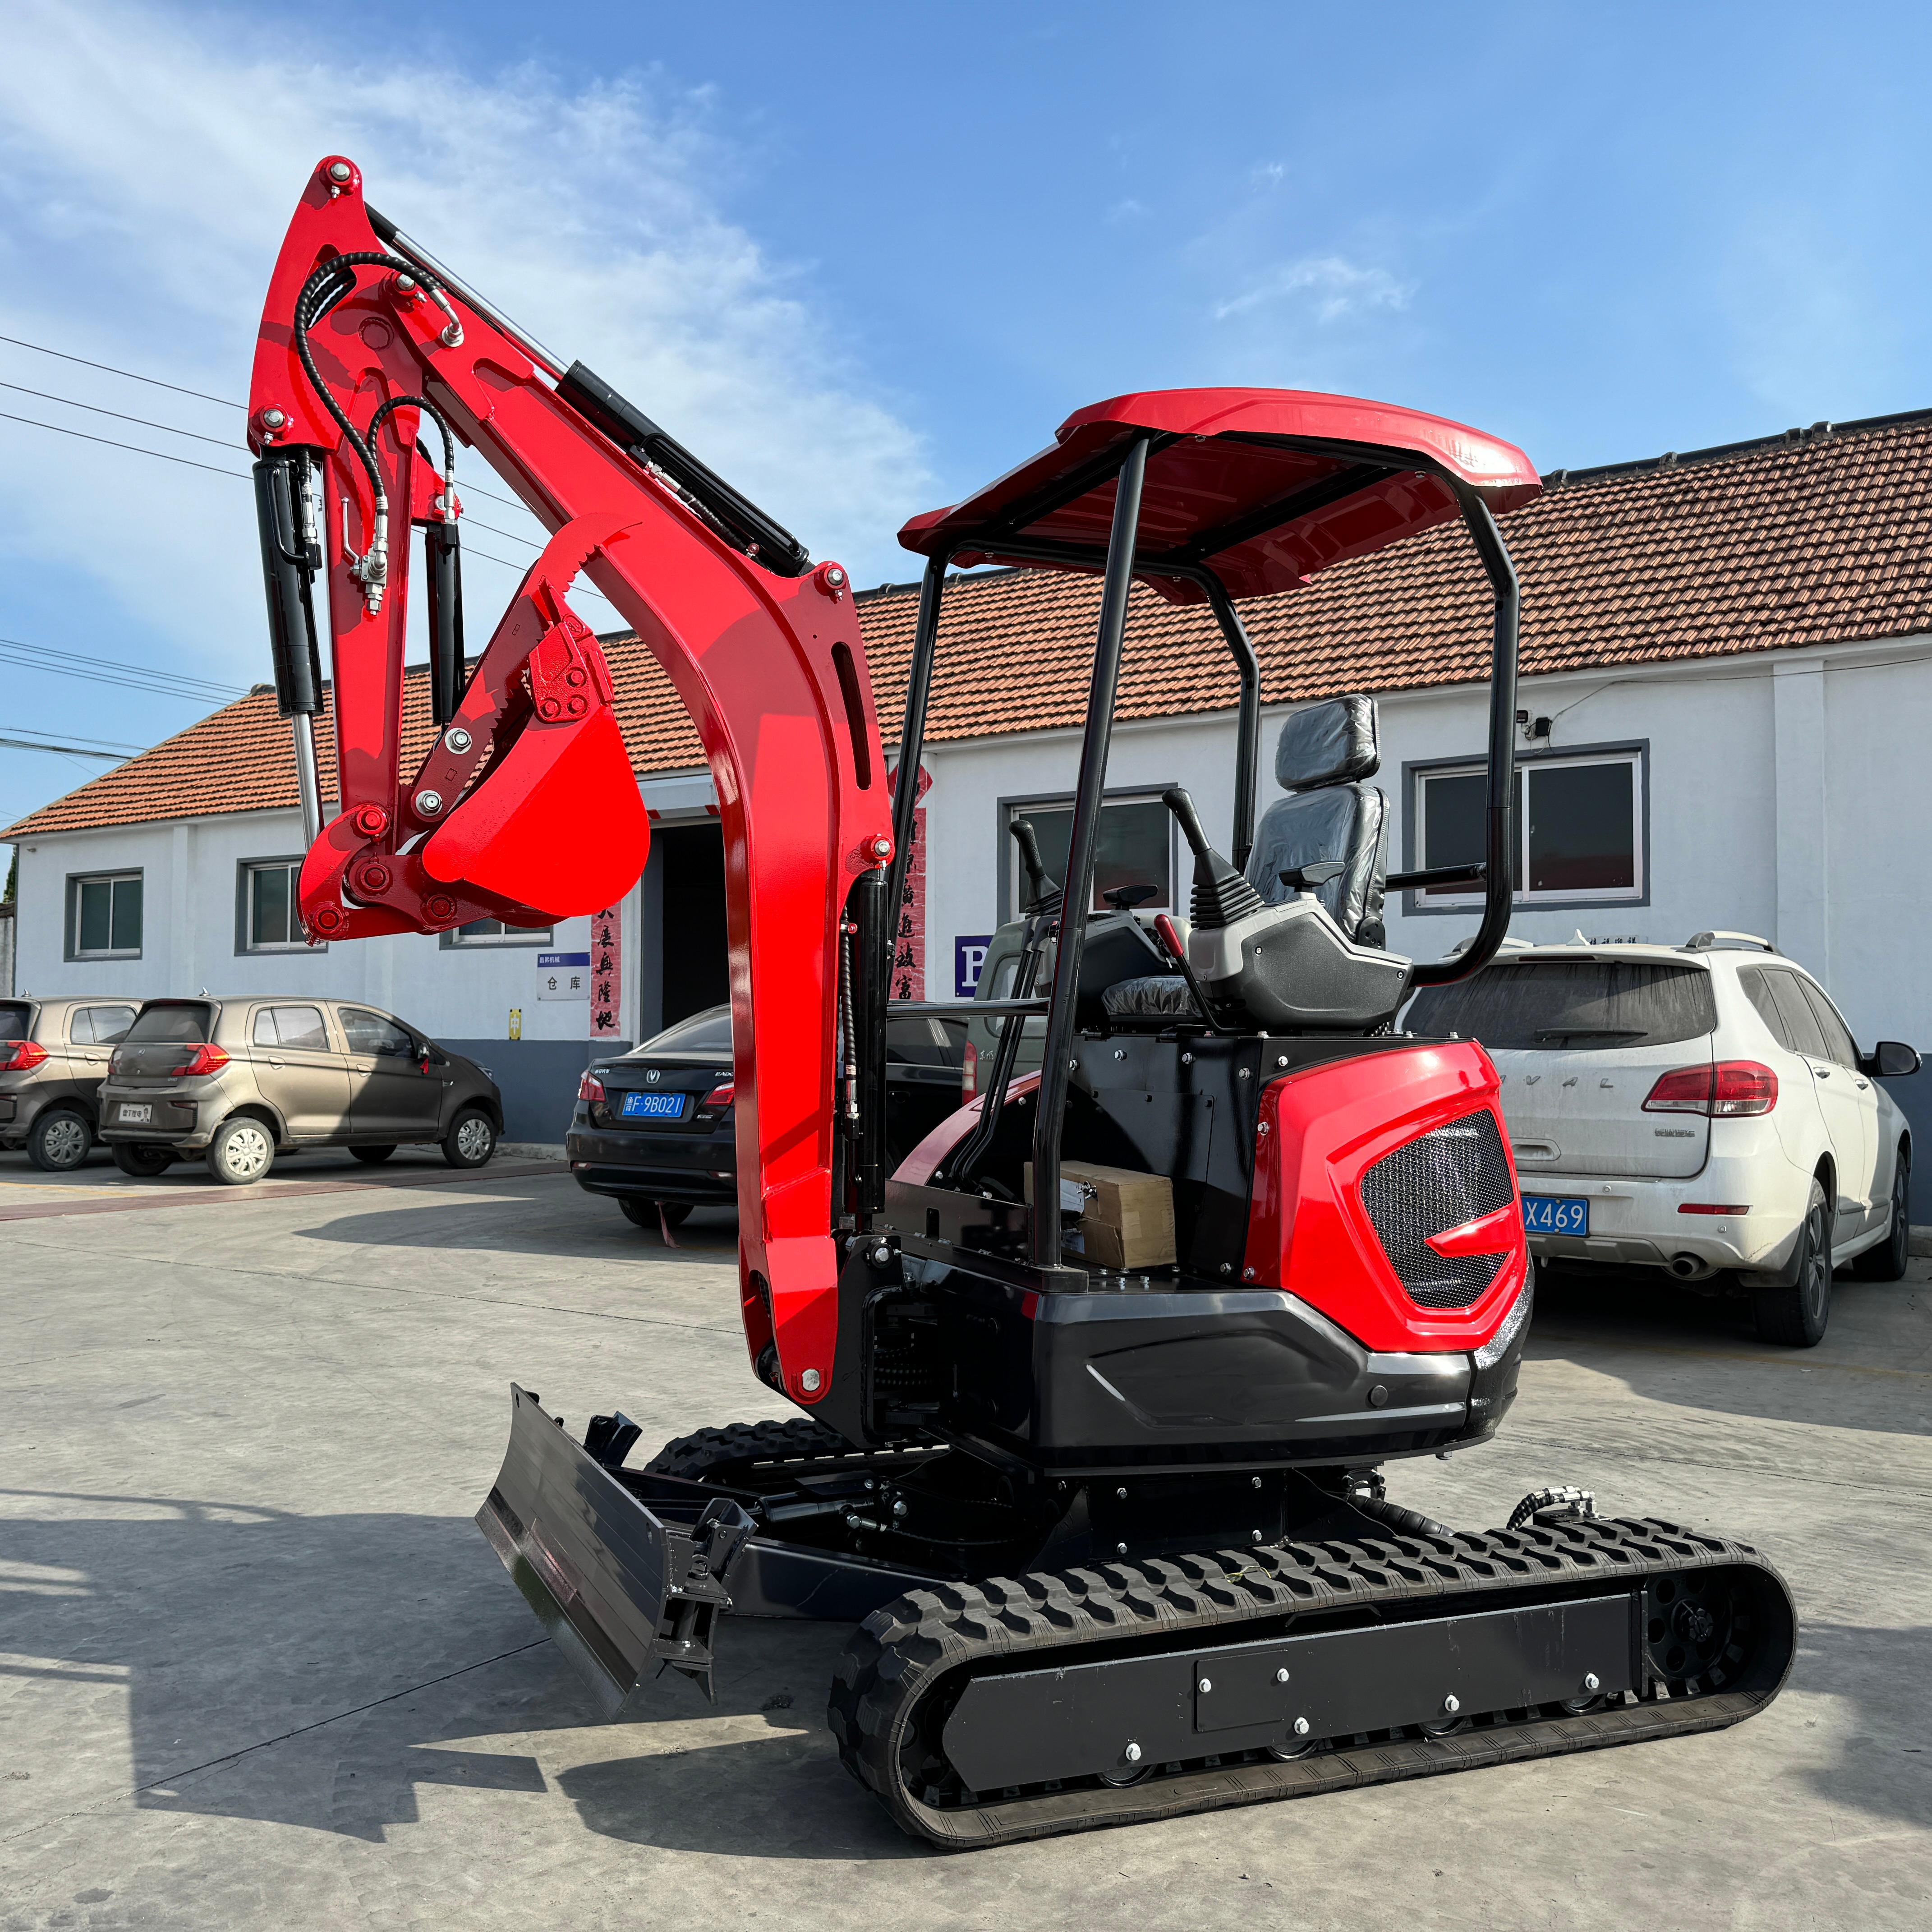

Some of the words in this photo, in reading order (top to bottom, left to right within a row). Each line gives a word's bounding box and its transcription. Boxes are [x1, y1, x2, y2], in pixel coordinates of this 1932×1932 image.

[962, 946, 989, 987] P
[547, 976, 580, 990] 仓库
[1526, 1201, 1583, 1228] X469
